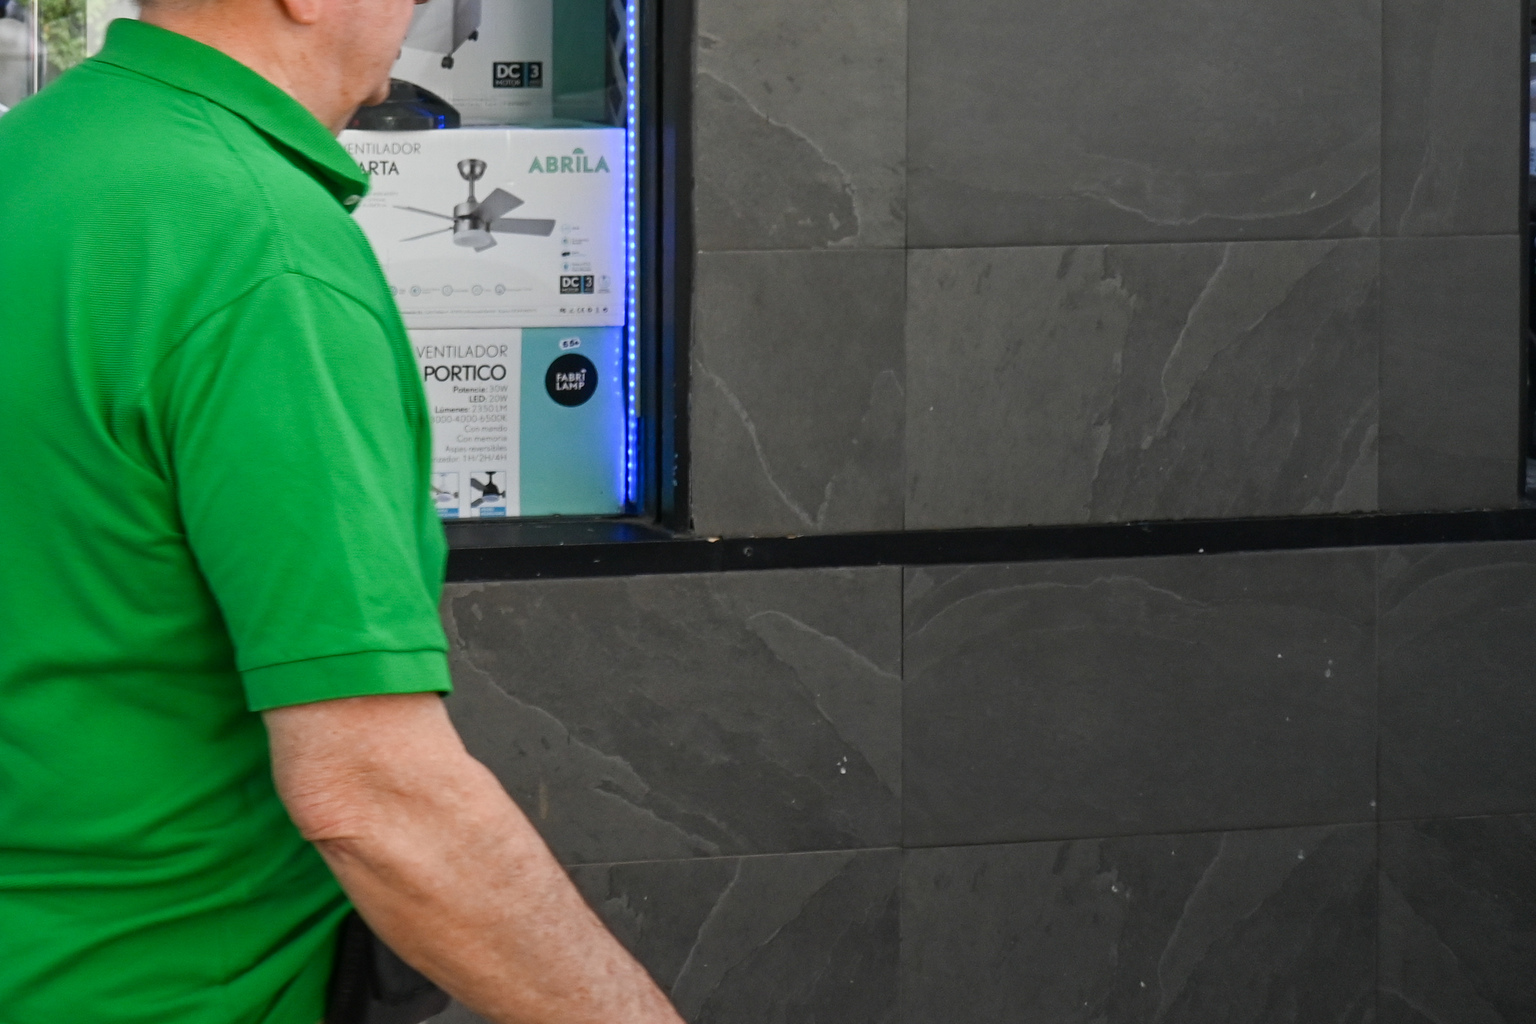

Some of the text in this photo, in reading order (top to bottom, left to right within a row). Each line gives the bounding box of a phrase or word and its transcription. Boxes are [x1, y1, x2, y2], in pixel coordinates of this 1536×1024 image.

[497, 64, 540, 78] DC 3
[562, 277, 579, 288] DC
[416, 344, 508, 359] VENTILADOR
[424, 364, 507, 382] PORTICO
[555, 381, 586, 391] LAMP
